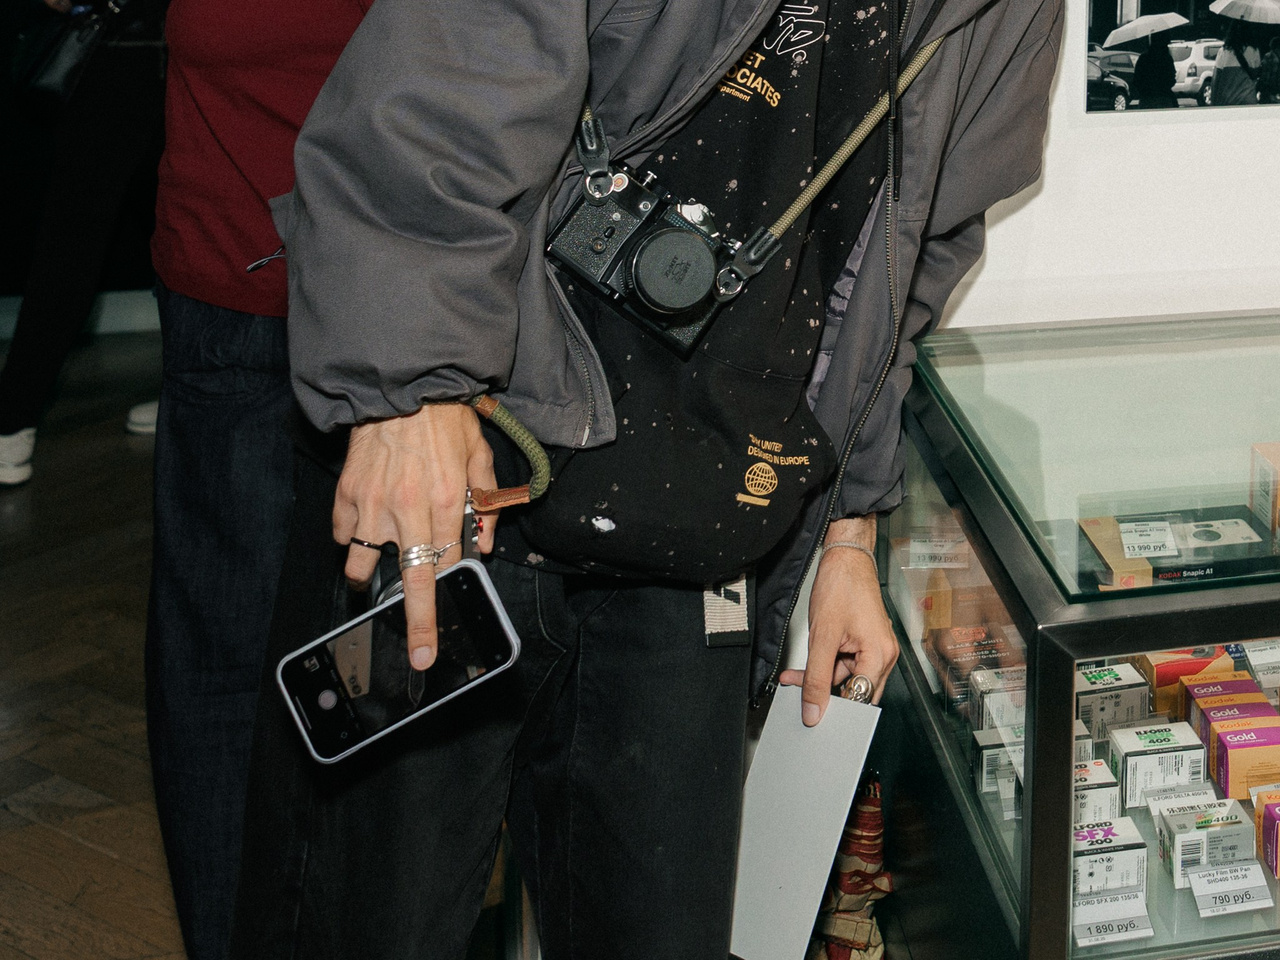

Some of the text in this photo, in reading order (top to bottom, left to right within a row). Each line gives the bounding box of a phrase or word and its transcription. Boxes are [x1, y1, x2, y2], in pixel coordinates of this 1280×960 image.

[726, 64, 781, 108] OCIATES
[719, 84, 751, 102] partment
[780, 456, 810, 466] EUROPE
[953, 652, 1010, 662] READY-TO-SHOOT
[1081, 667, 1114, 676] ILFORD
[1194, 685, 1222, 694] Gold
[1210, 708, 1239, 717] Gold
[1220, 721, 1253, 729] Kodak
[1226, 732, 1257, 742] Gold
[1073, 821, 1113, 831] LFORD
[1073, 826, 1119, 841] SFX
[1087, 838, 1113, 846] 200
[1198, 871, 1215, 879] Lucky
[1096, 896, 1108, 904] SFX
[1212, 890, 1254, 905] 790 руб.
[1096, 923, 1114, 934] 890
[1117, 920, 1139, 933] руб.
